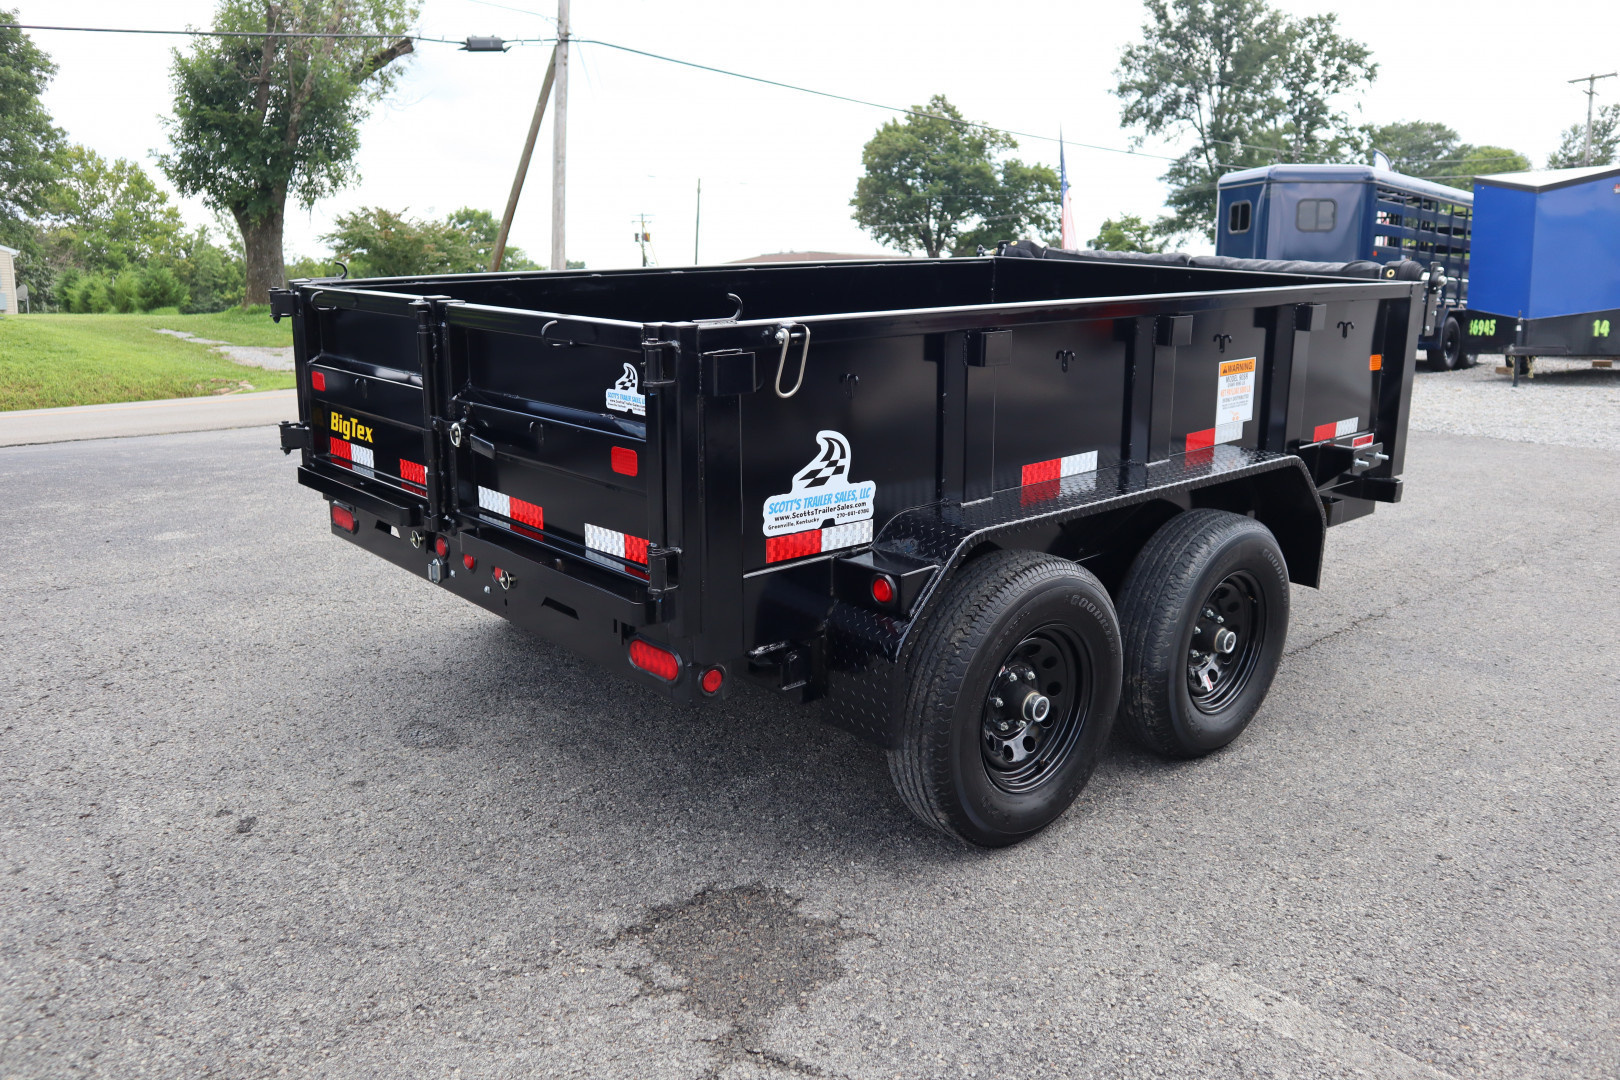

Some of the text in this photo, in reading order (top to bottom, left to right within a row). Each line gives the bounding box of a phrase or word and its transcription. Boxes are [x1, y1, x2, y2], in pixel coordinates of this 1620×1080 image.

[1469, 319, 1496, 336] $6945
[1592, 319, 1611, 337] 14
[1228, 362, 1252, 373] WARNING
[1226, 375, 1238, 383] MODEL
[330, 411, 374, 443] BigTex
[768, 487, 872, 515] SCOTT'S TRAILER SALES, LLC
[774, 501, 867, 522] www.ScottsTrailerSales.com
[768, 517, 820, 530] Greenville, Kentucky
